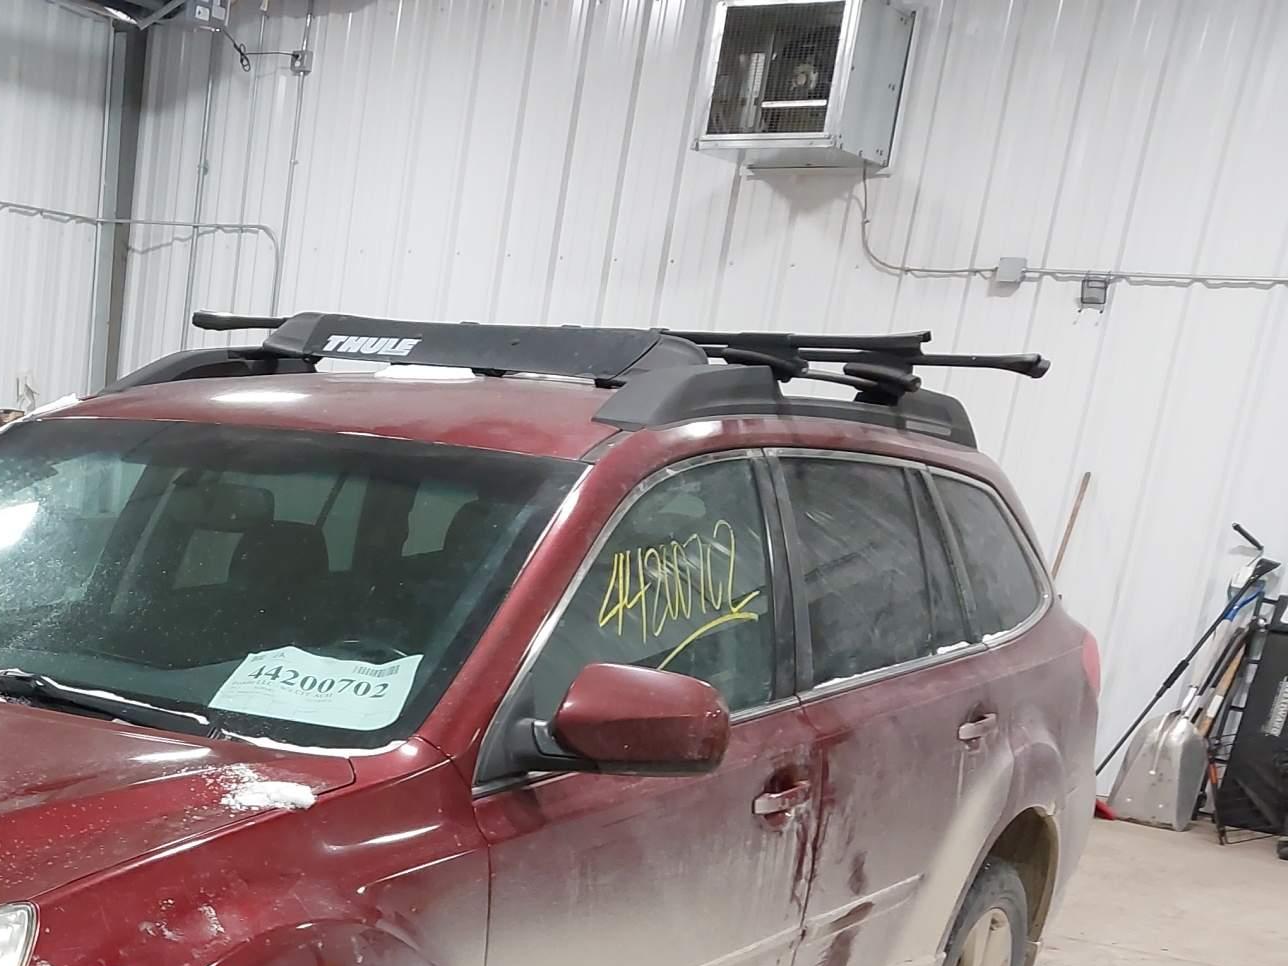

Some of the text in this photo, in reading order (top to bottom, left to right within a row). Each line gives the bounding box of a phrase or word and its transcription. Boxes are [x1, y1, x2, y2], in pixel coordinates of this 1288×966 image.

[322, 334, 423, 356] THULE
[599, 519, 760, 644] 44200702
[248, 664, 390, 698] 44200702
